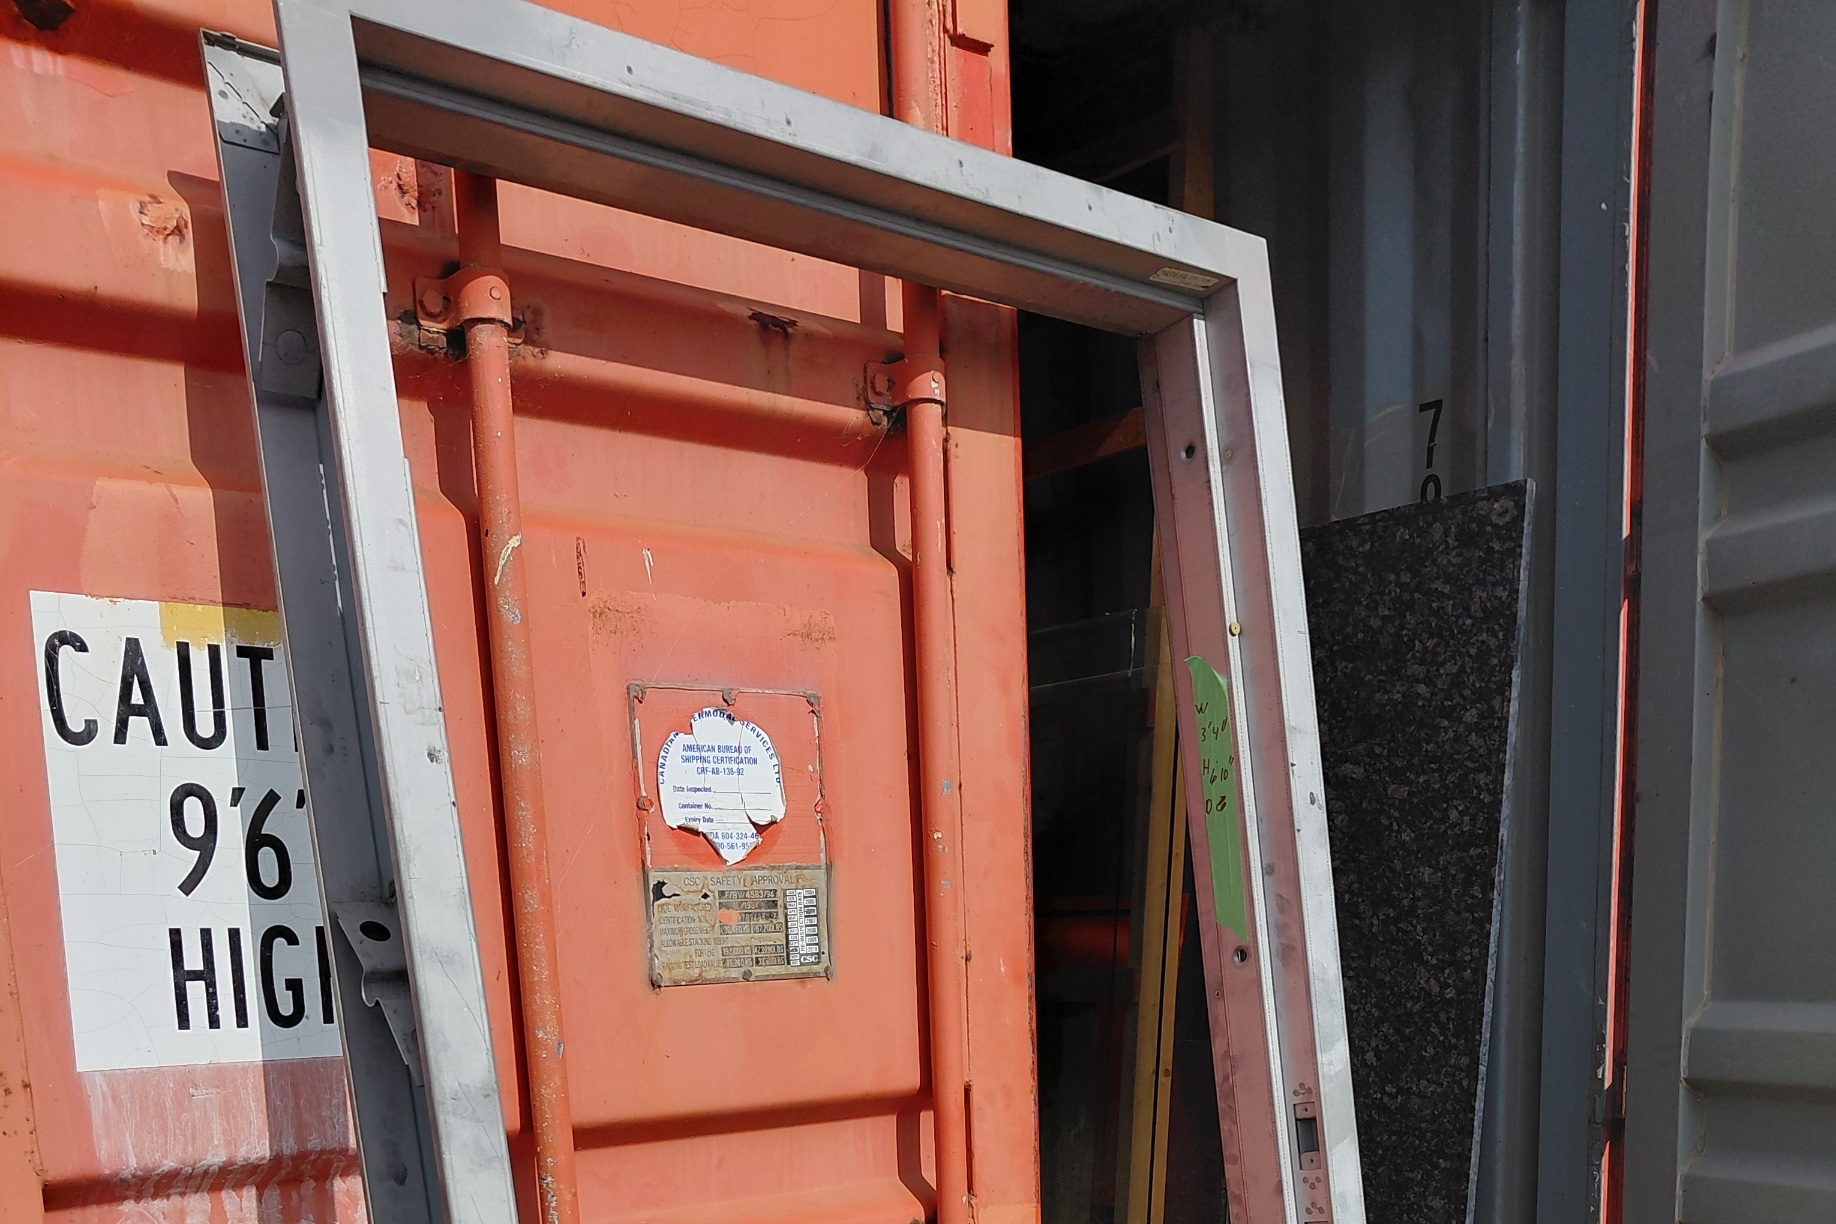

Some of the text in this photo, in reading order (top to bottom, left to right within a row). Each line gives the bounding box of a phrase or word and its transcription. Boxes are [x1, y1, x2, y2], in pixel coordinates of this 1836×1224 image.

[1195, 701, 1209, 715] W
[692, 709, 738, 722] ERMODAL
[682, 744, 752, 754] AMERICAN BUREAU OF
[680, 755, 758, 766] SHIPPING CERTIFICATION
[1203, 758, 1210, 776] H
[673, 785, 712, 794] Date Inspected
[678, 802, 703, 810] Container
[684, 816, 714, 824] Expiry Date
[721, 832, 759, 840] 604-324-46
[683, 874, 795, 886] CSC SAFETY APPROVAL
[800, 954, 819, 964] CSC
